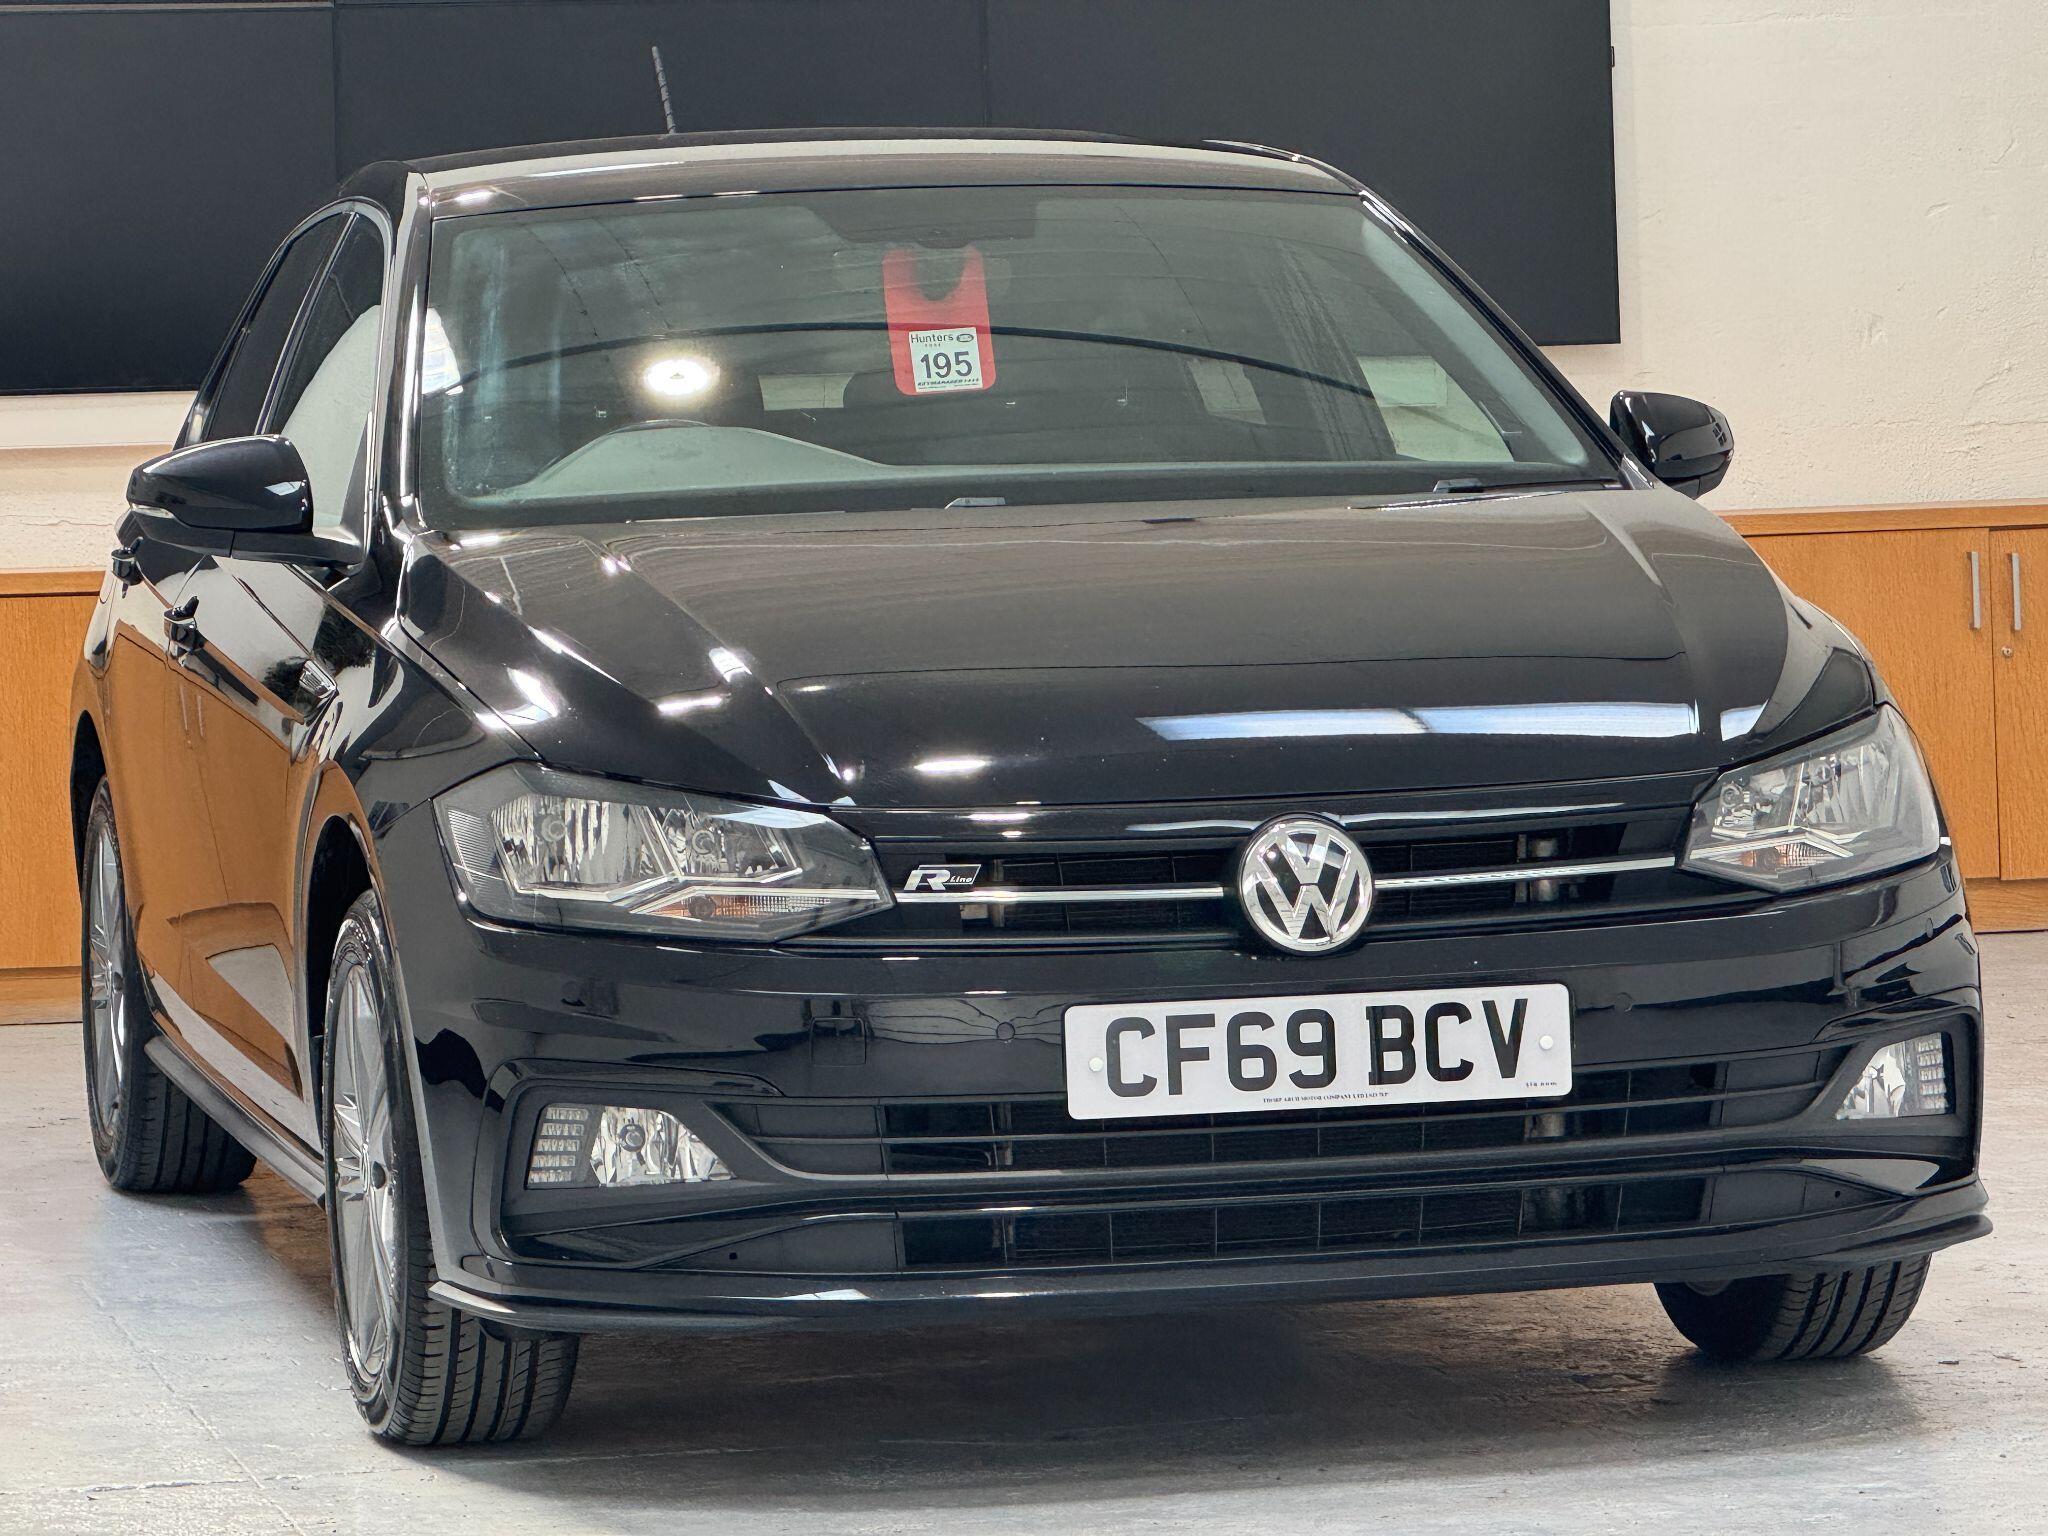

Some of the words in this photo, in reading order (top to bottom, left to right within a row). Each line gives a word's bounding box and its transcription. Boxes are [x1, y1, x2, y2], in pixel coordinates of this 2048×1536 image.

[910, 333, 954, 343] Hunters
[920, 350, 973, 378] 195
[1105, 1008, 1337, 1098] CF69
[1365, 998, 1529, 1086] BCV
